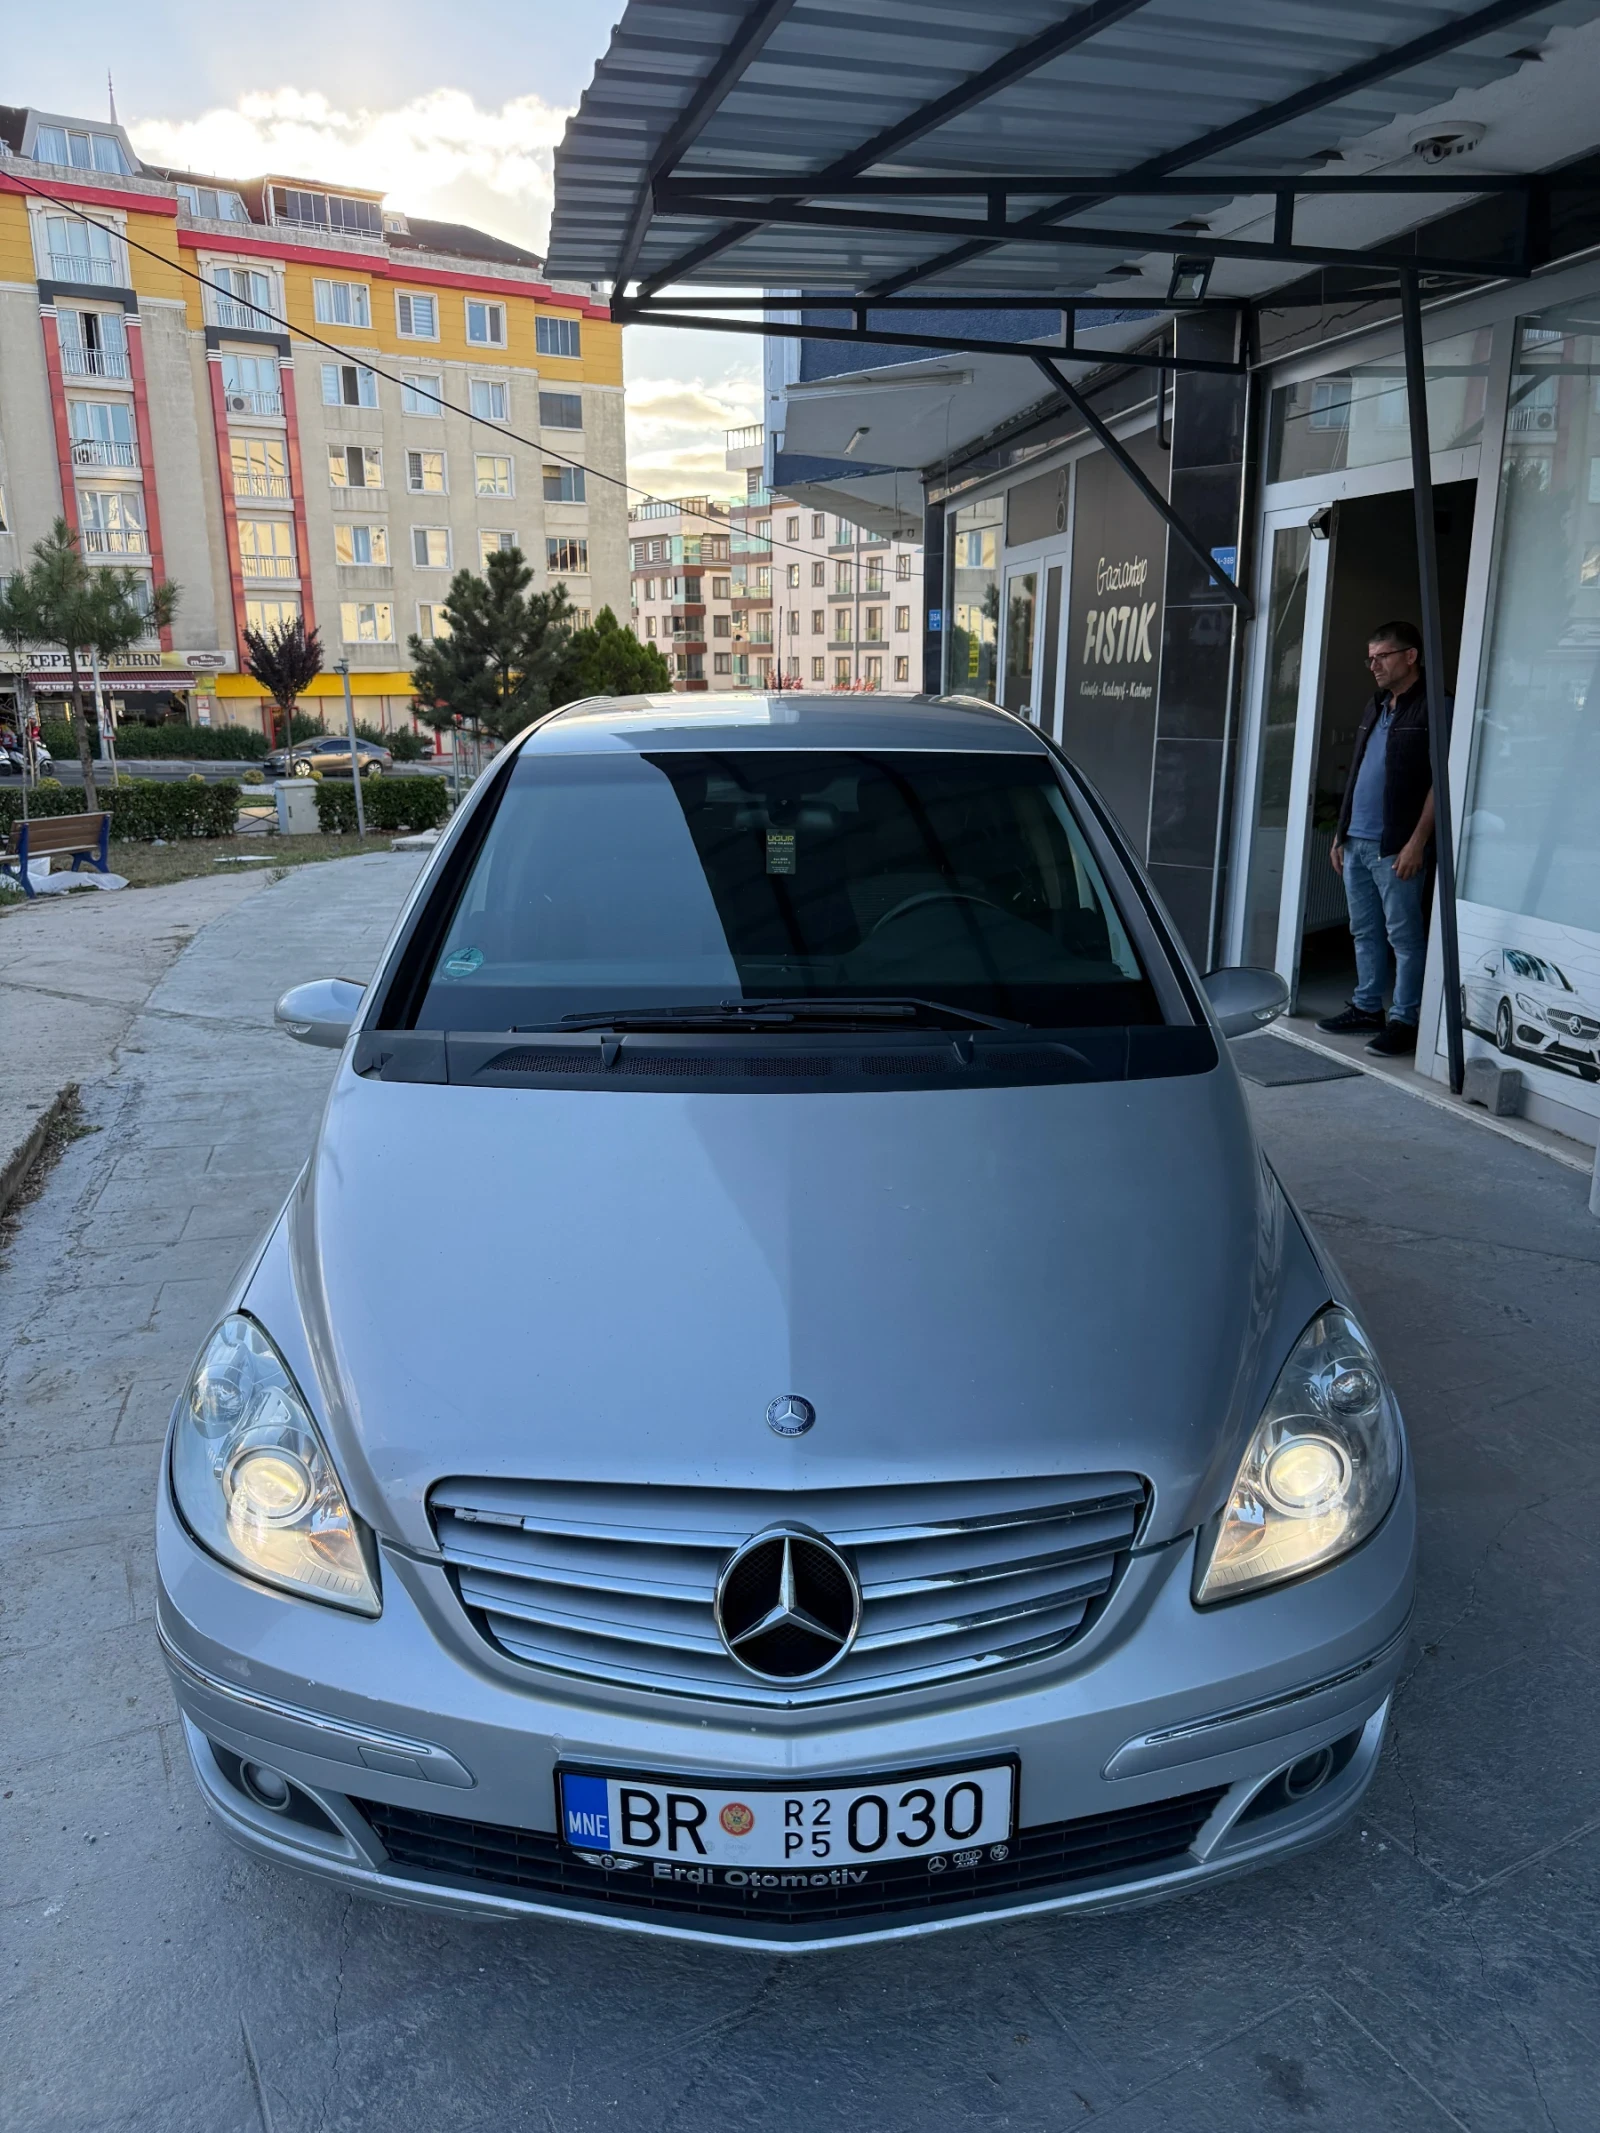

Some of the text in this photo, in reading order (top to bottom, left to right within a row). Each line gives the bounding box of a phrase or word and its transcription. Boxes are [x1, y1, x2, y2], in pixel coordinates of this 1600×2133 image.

[1097, 555, 1148, 597] Gaziantep
[1083, 602, 1157, 665] FISTIK
[26, 654, 72, 667] TEPE
[115, 653, 161, 667] FIRIN
[568, 1810, 609, 1839] MNE
[619, 1787, 708, 1854] BR
[848, 1781, 984, 1853] 030
[653, 1862, 869, 1887] Erdi Otomotiv
